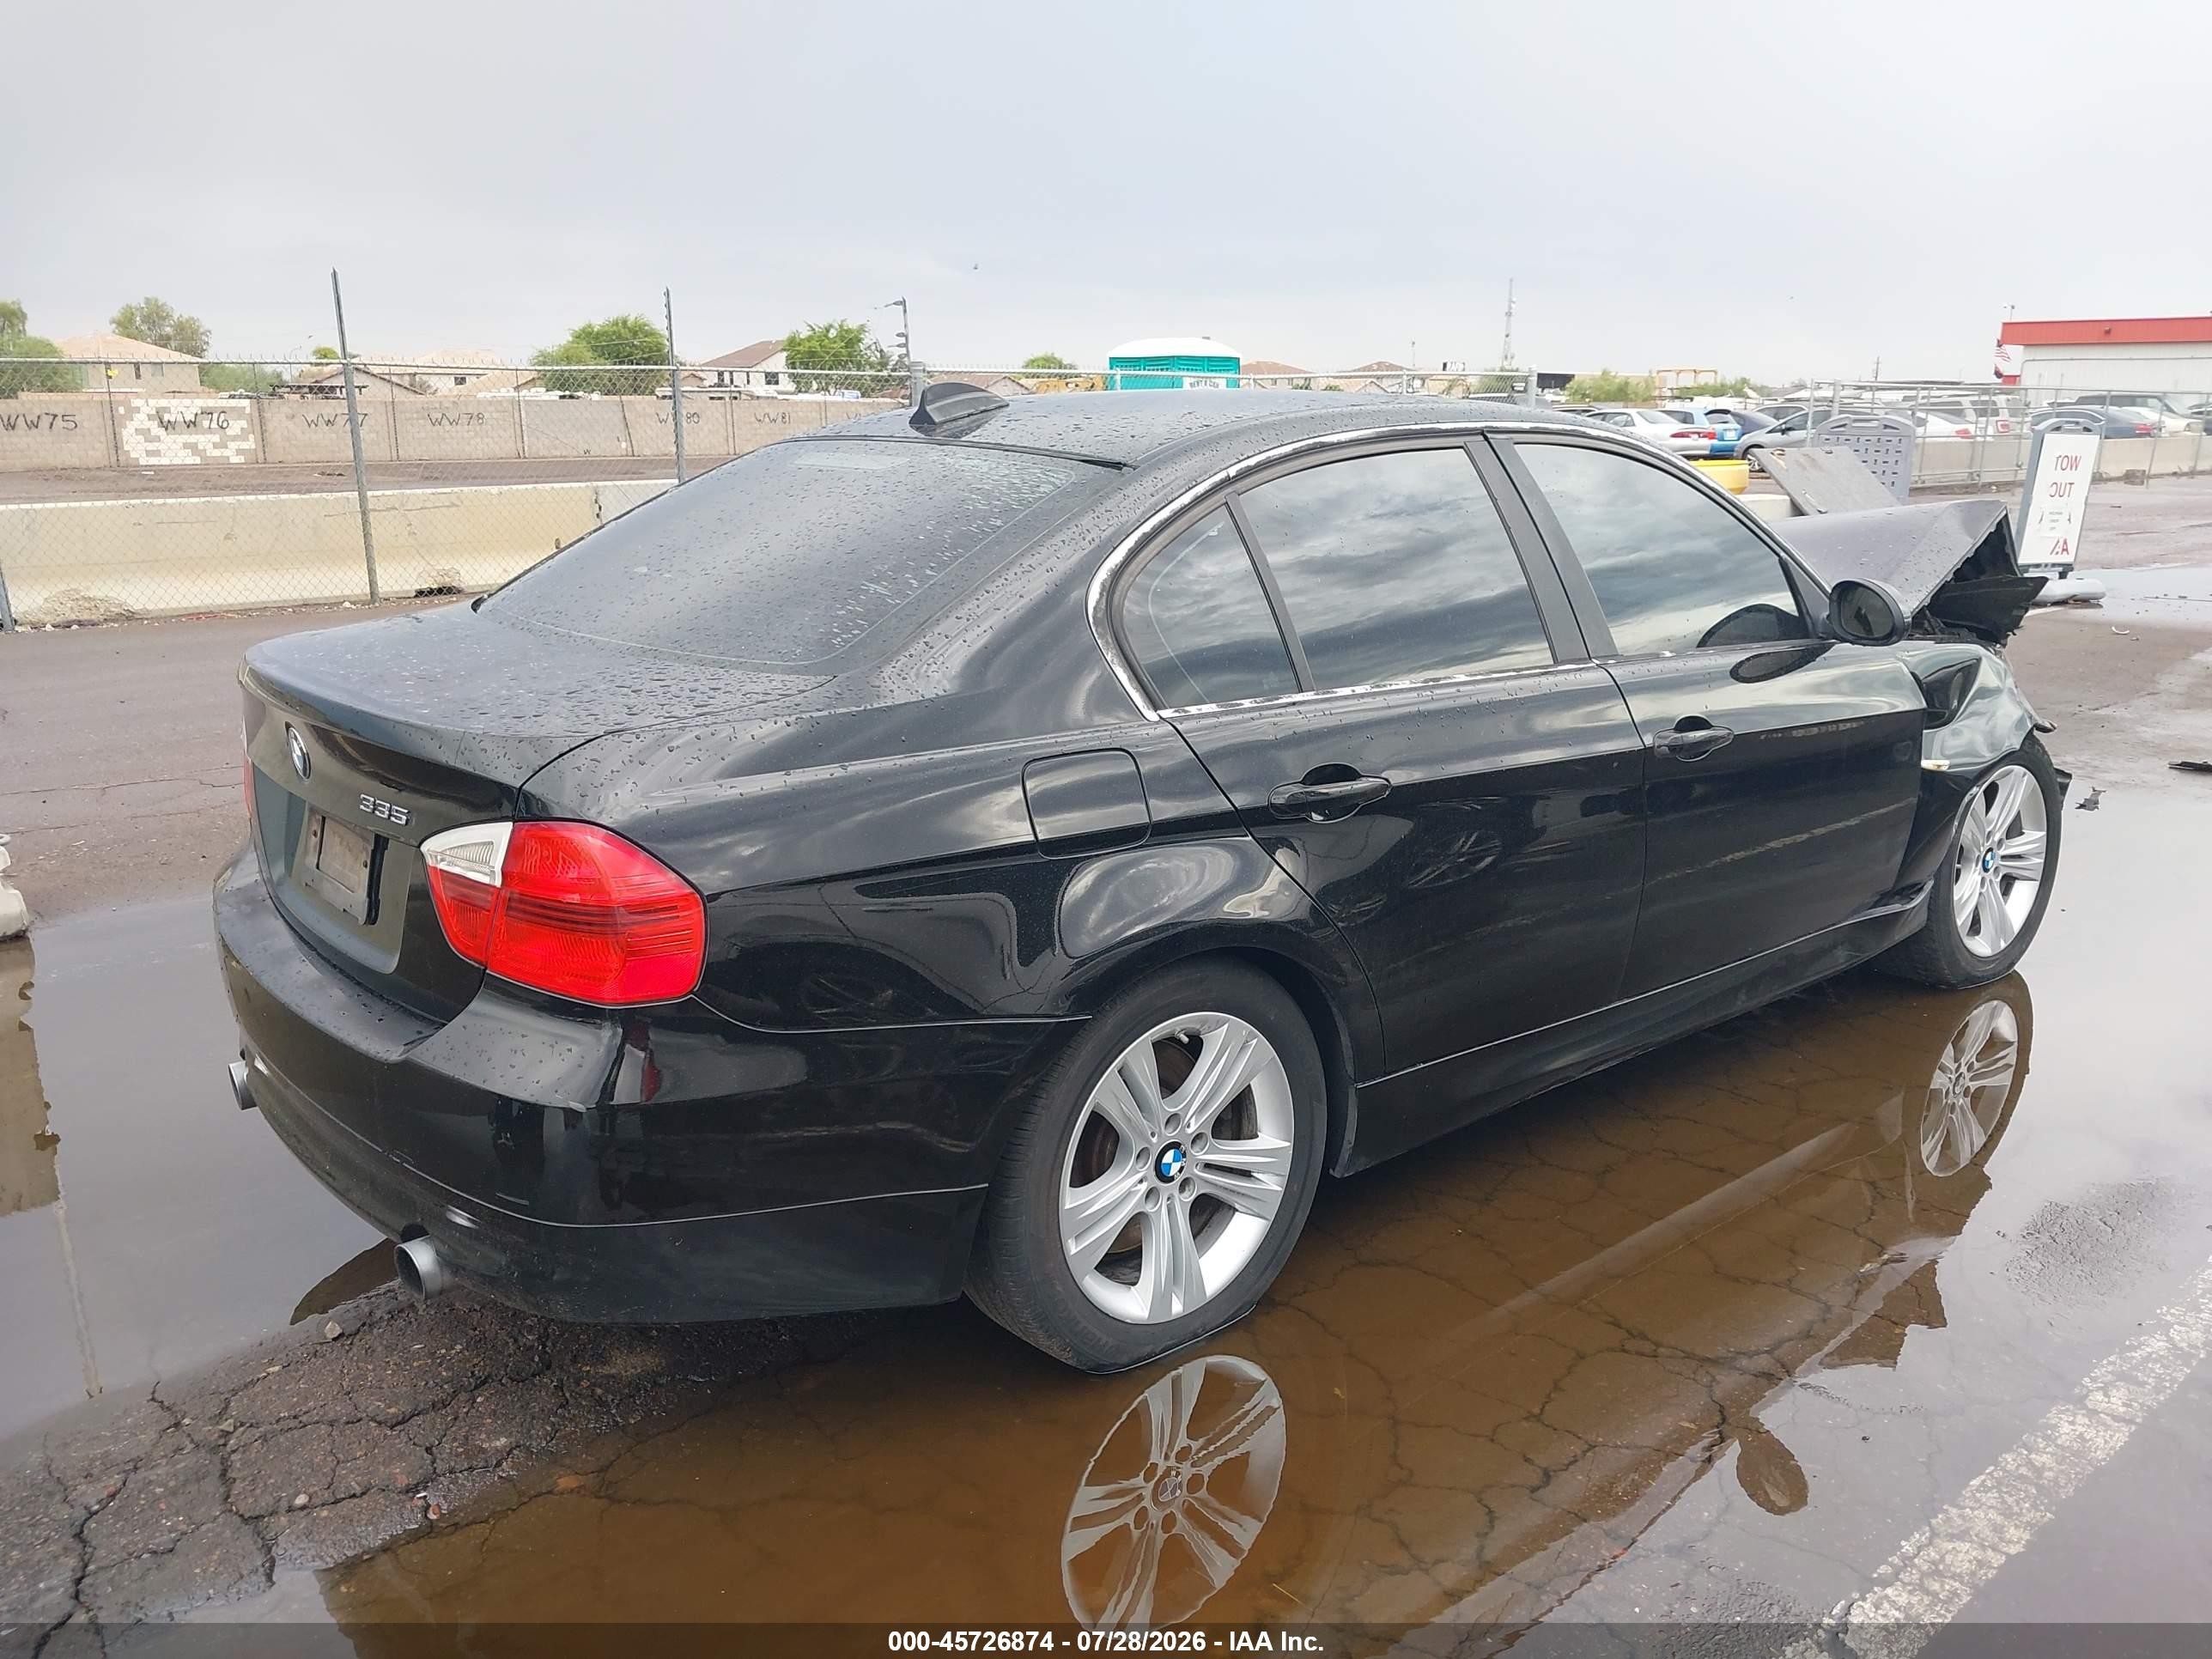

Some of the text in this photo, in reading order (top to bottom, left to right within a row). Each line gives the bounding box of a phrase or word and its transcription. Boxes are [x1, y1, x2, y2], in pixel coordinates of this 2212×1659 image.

[155, 410, 230, 431] WW76
[428, 412, 486, 427] WW78
[2054, 454, 2082, 471] TOW
